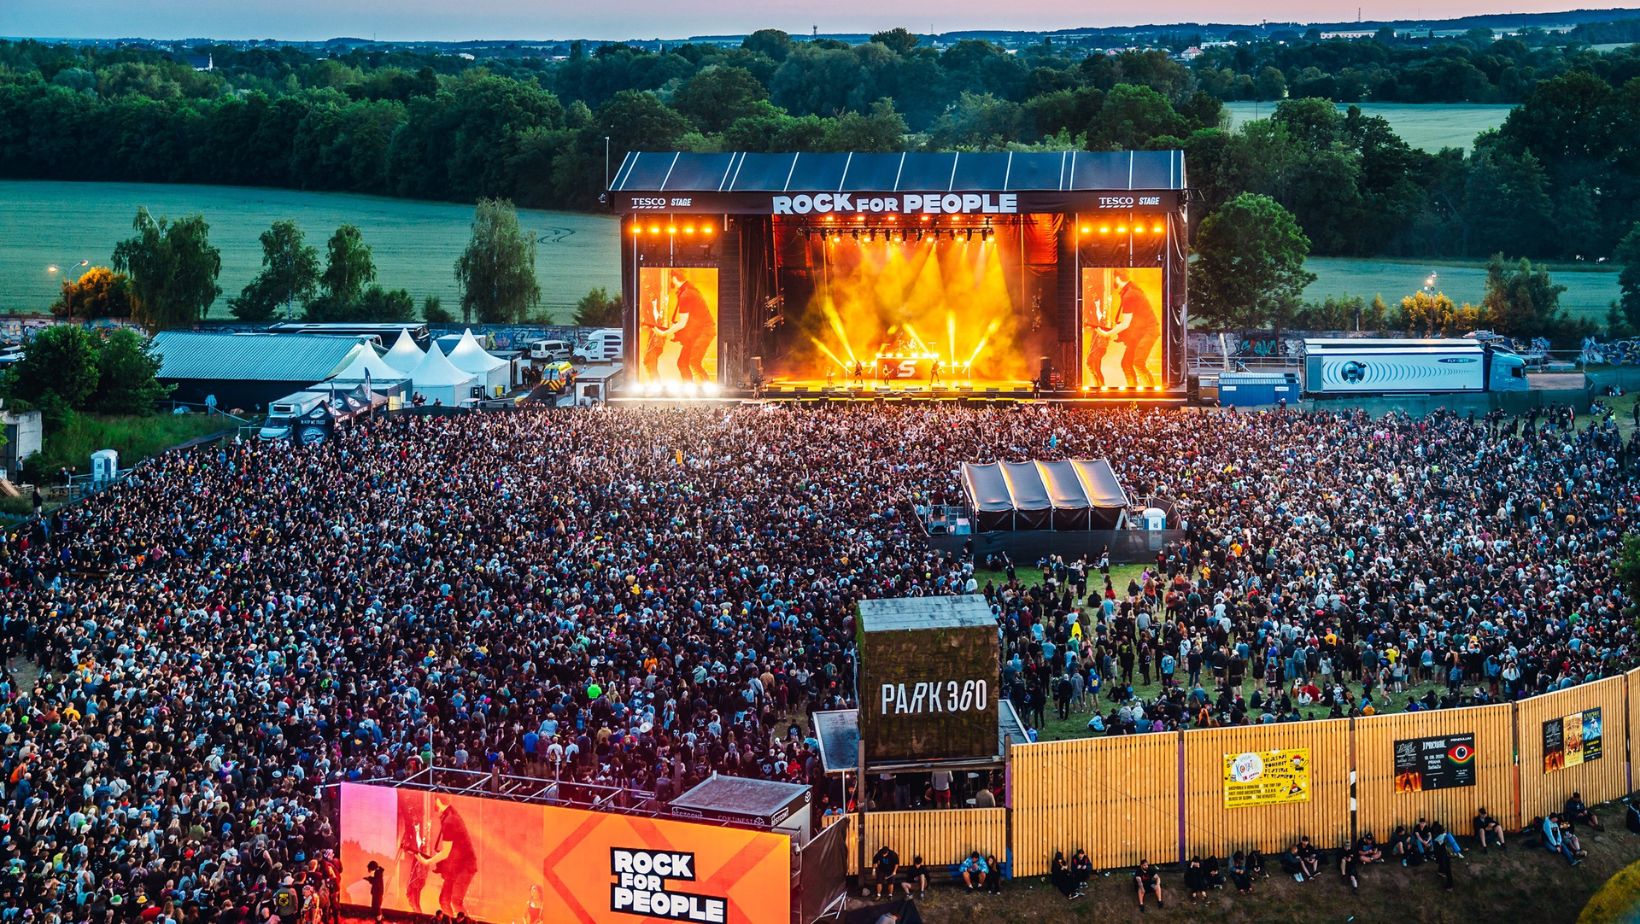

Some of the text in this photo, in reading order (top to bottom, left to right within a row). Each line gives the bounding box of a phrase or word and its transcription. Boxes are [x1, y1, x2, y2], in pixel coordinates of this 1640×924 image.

[631, 197, 692, 207] TESCO STAGE
[772, 193, 1017, 215] ROCK FOR PEOPLE
[1099, 197, 1160, 206] TESCO STAGE
[613, 850, 693, 878] ROCK
[621, 872, 661, 892] FOR
[614, 887, 724, 923] PEOPLE
